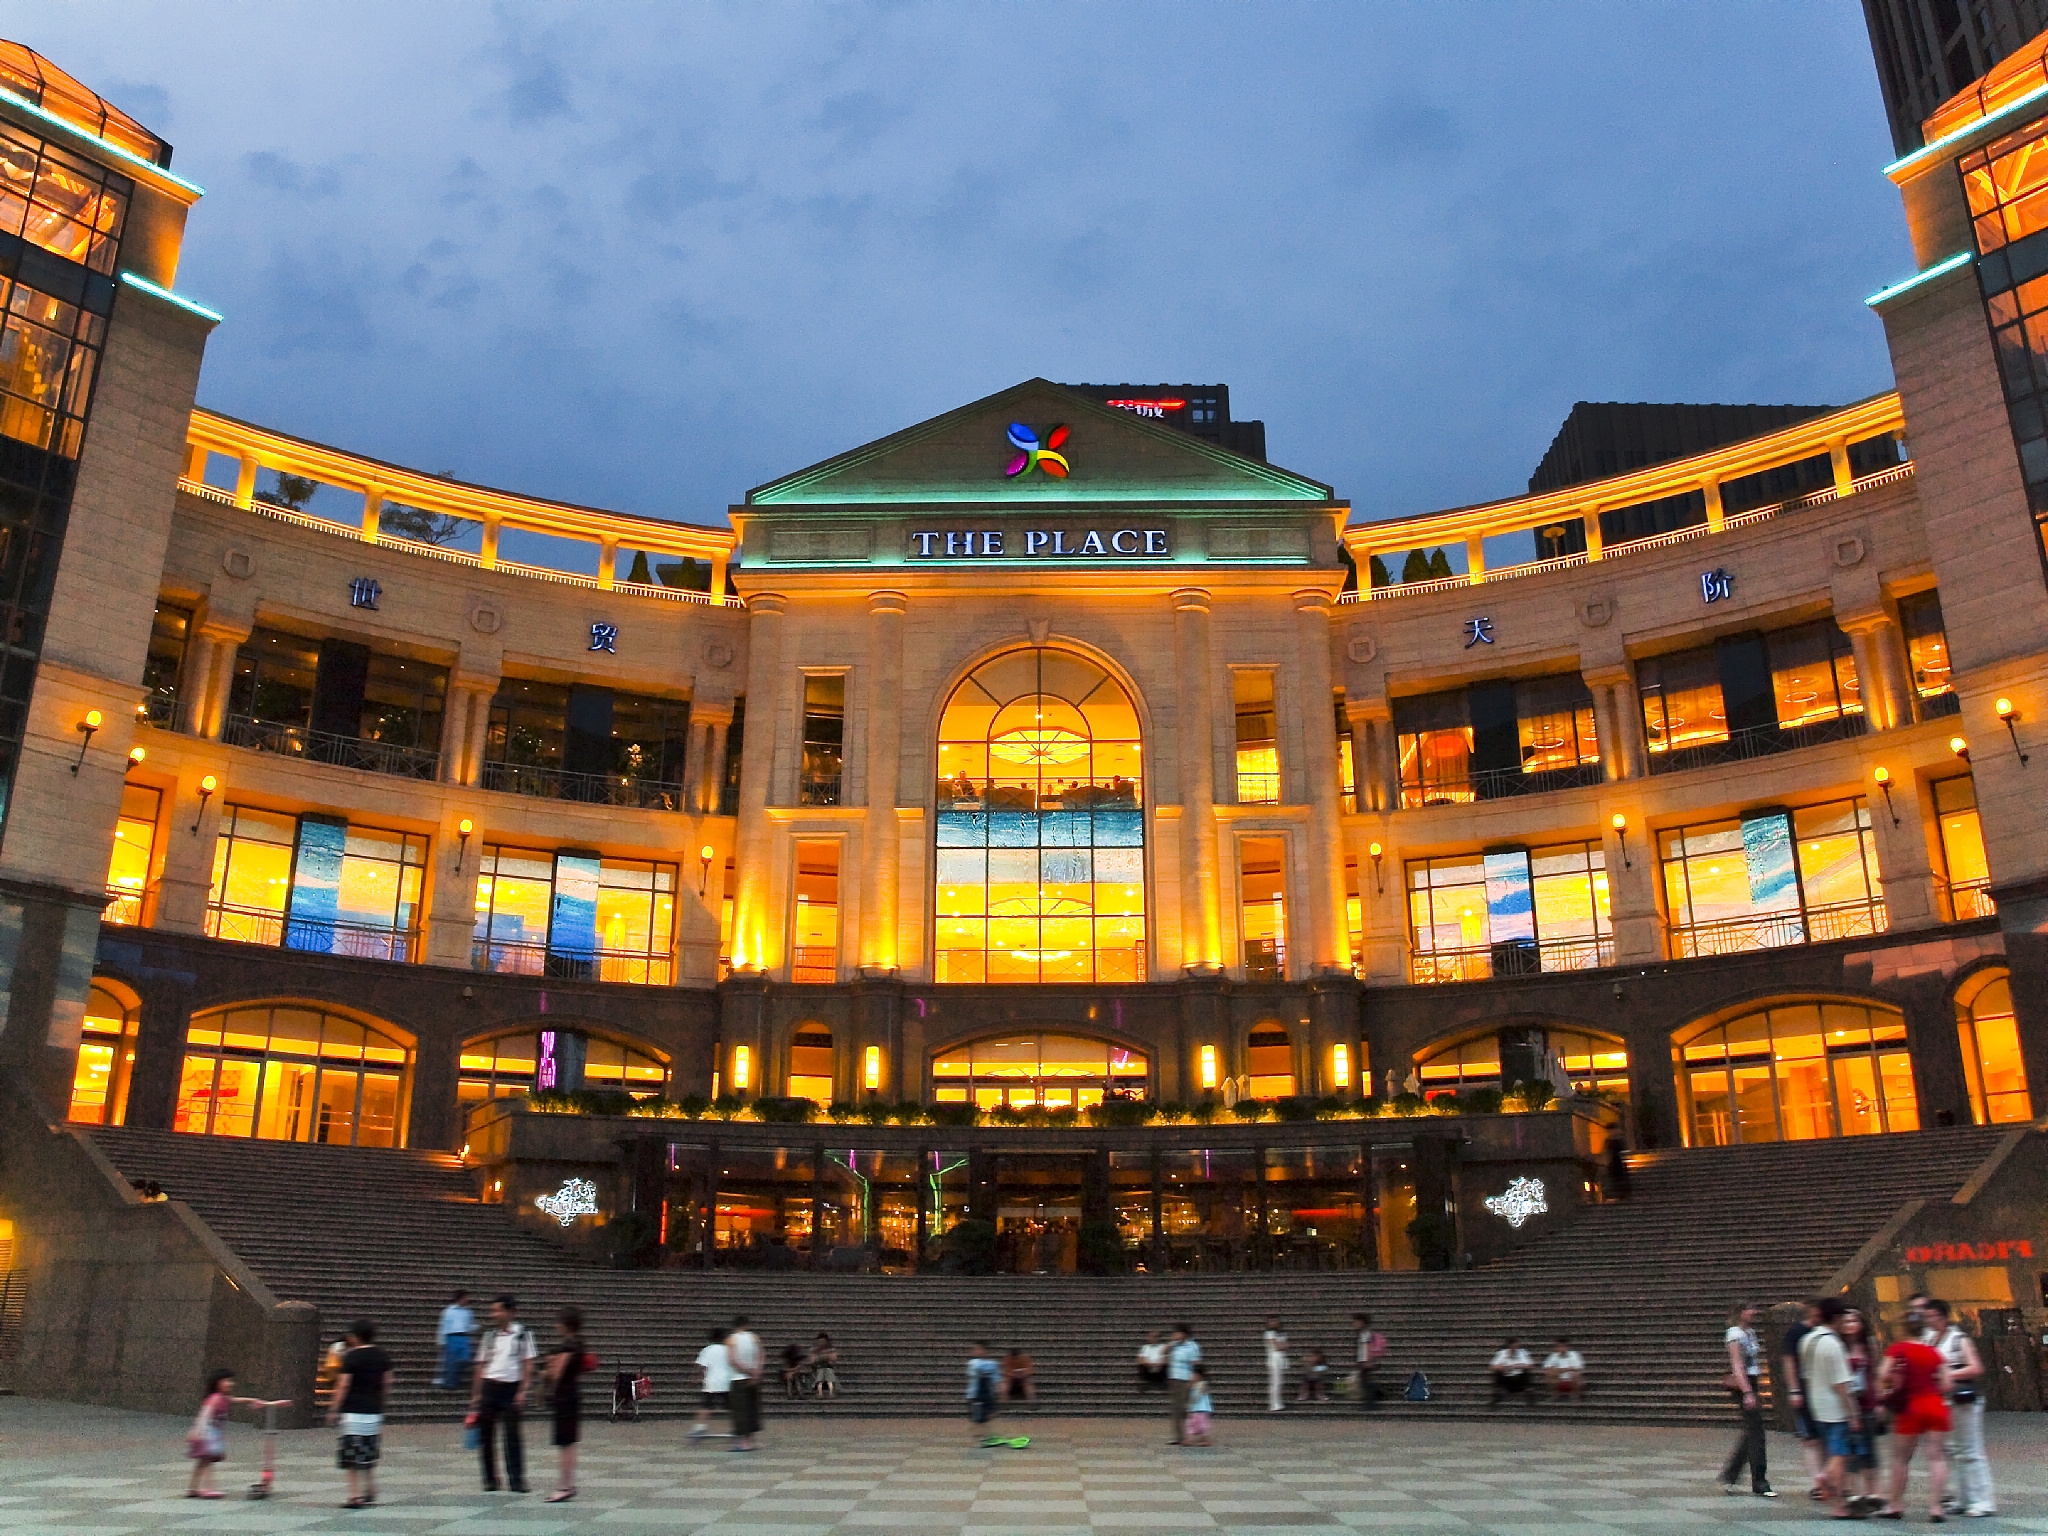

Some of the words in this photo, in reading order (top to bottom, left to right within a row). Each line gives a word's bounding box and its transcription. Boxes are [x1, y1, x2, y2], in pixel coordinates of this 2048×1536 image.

[912, 530, 1005, 556] THE
[1024, 529, 1168, 556] PLACE
[349, 577, 383, 611] 世
[588, 622, 618, 654] 贸
[1464, 616, 1495, 649] 天
[1701, 568, 1735, 604] 阶
